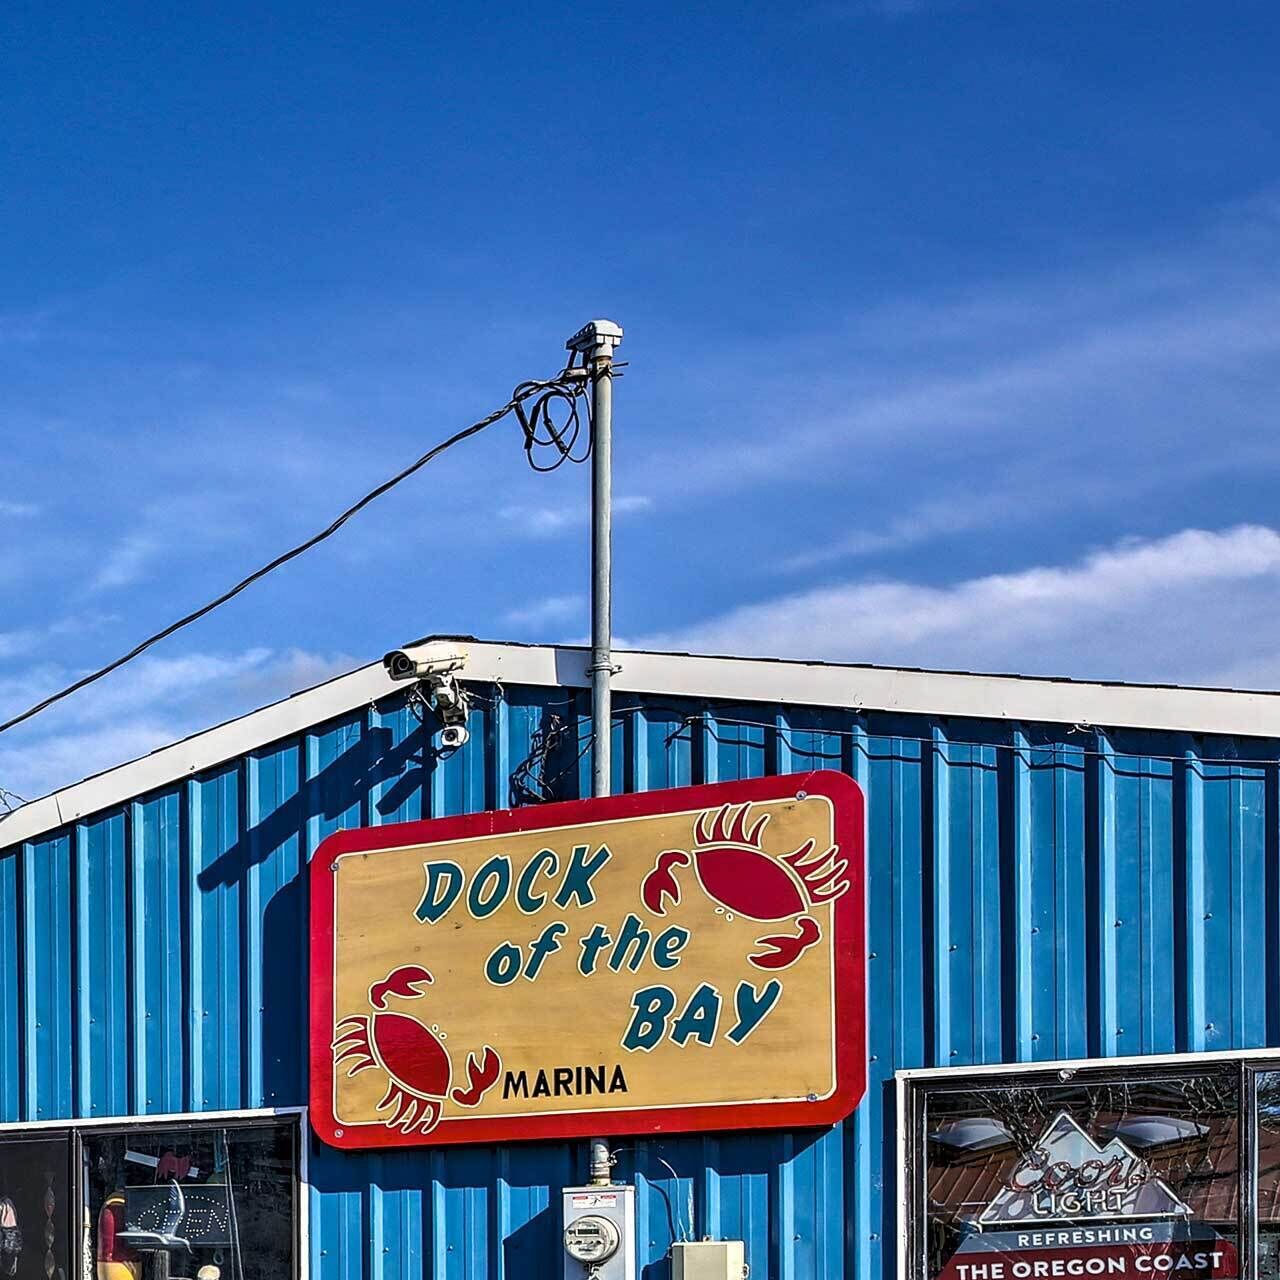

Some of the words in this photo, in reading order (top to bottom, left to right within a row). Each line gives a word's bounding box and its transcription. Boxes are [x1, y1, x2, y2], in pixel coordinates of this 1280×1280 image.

[413, 844, 613, 924] DOCK
[484, 920, 568, 987] of
[576, 914, 691, 977] the
[621, 979, 782, 1053] BAY
[502, 1065, 629, 1100] MARINA
[1032, 1189, 1129, 1214] LIGHT
[138, 1209, 229, 1234] OPEN
[1017, 1226, 1154, 1247] REFRESHING
[956, 1263, 1005, 1280] THE
[1012, 1256, 1126, 1279] OREGON
[1134, 1251, 1224, 1273] COAST
